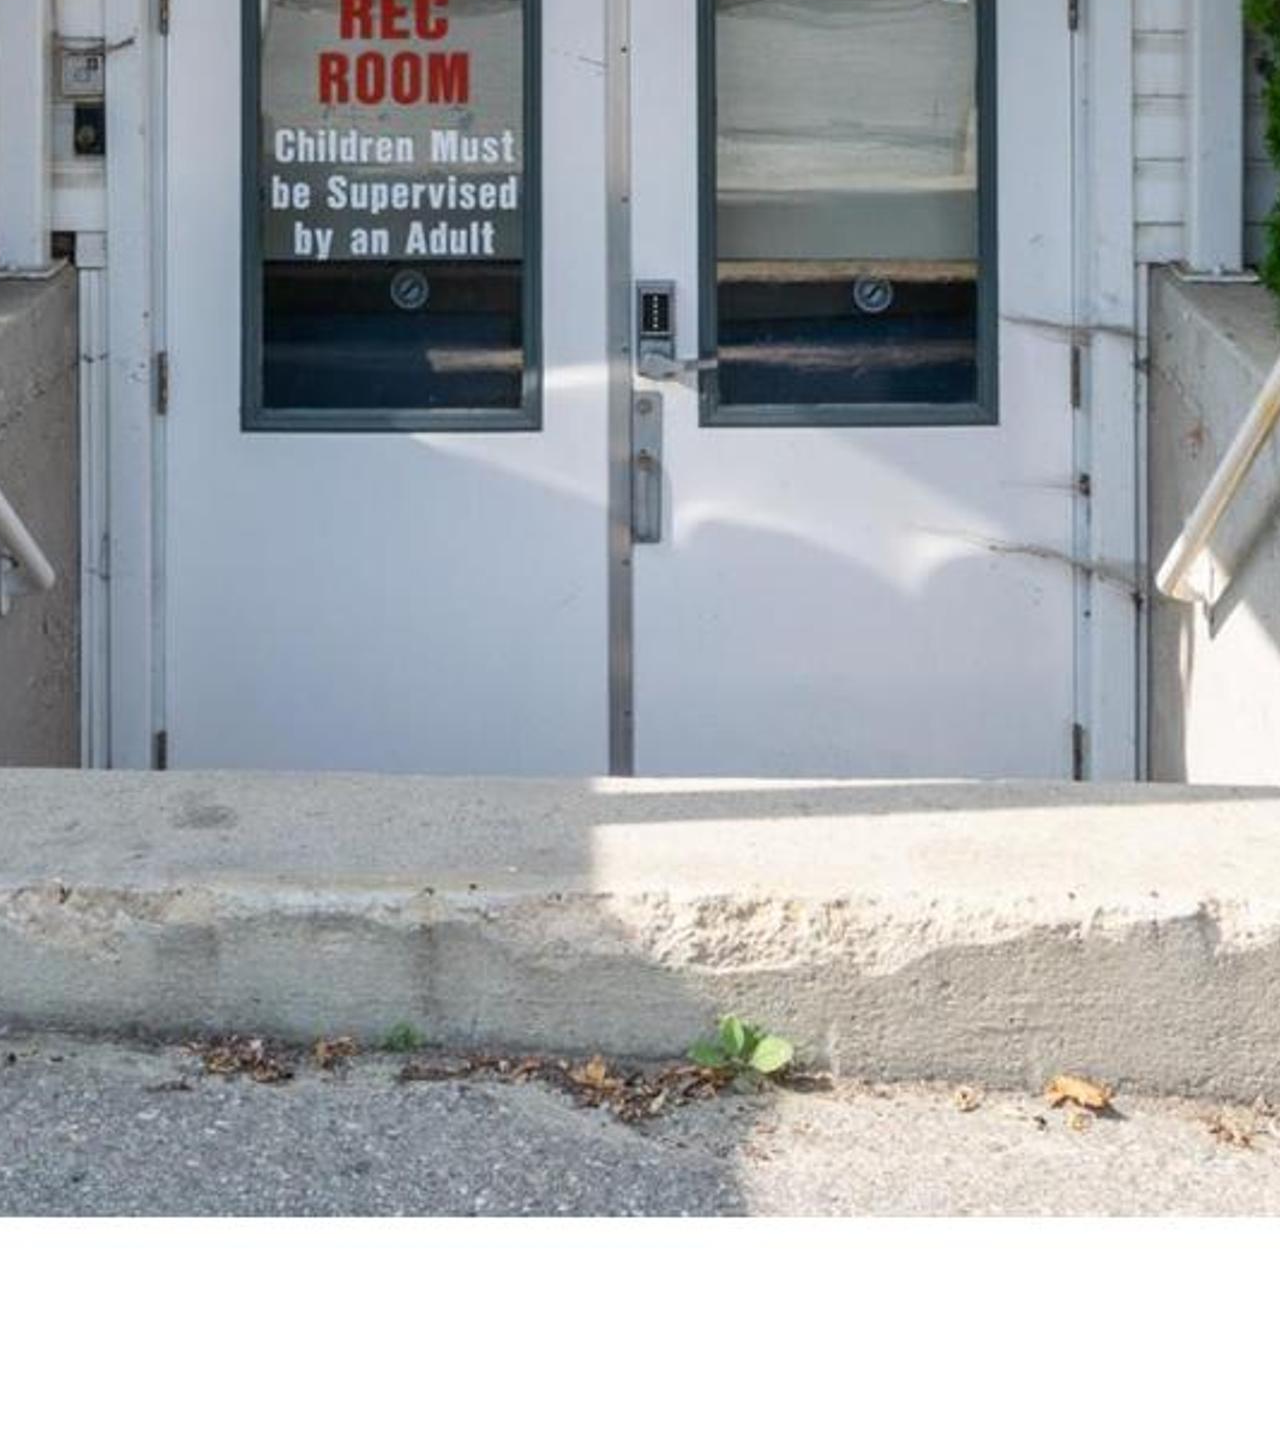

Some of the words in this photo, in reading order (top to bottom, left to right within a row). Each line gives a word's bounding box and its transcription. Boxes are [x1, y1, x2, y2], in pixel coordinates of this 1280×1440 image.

[319, 51, 469, 106] ROOM
[275, 128, 414, 163] Children
[431, 128, 515, 163] Must
[272, 176, 310, 209] be
[327, 175, 517, 214] Supervised
[295, 222, 333, 260] by
[351, 228, 389, 255] an
[406, 222, 495, 255] Adult
